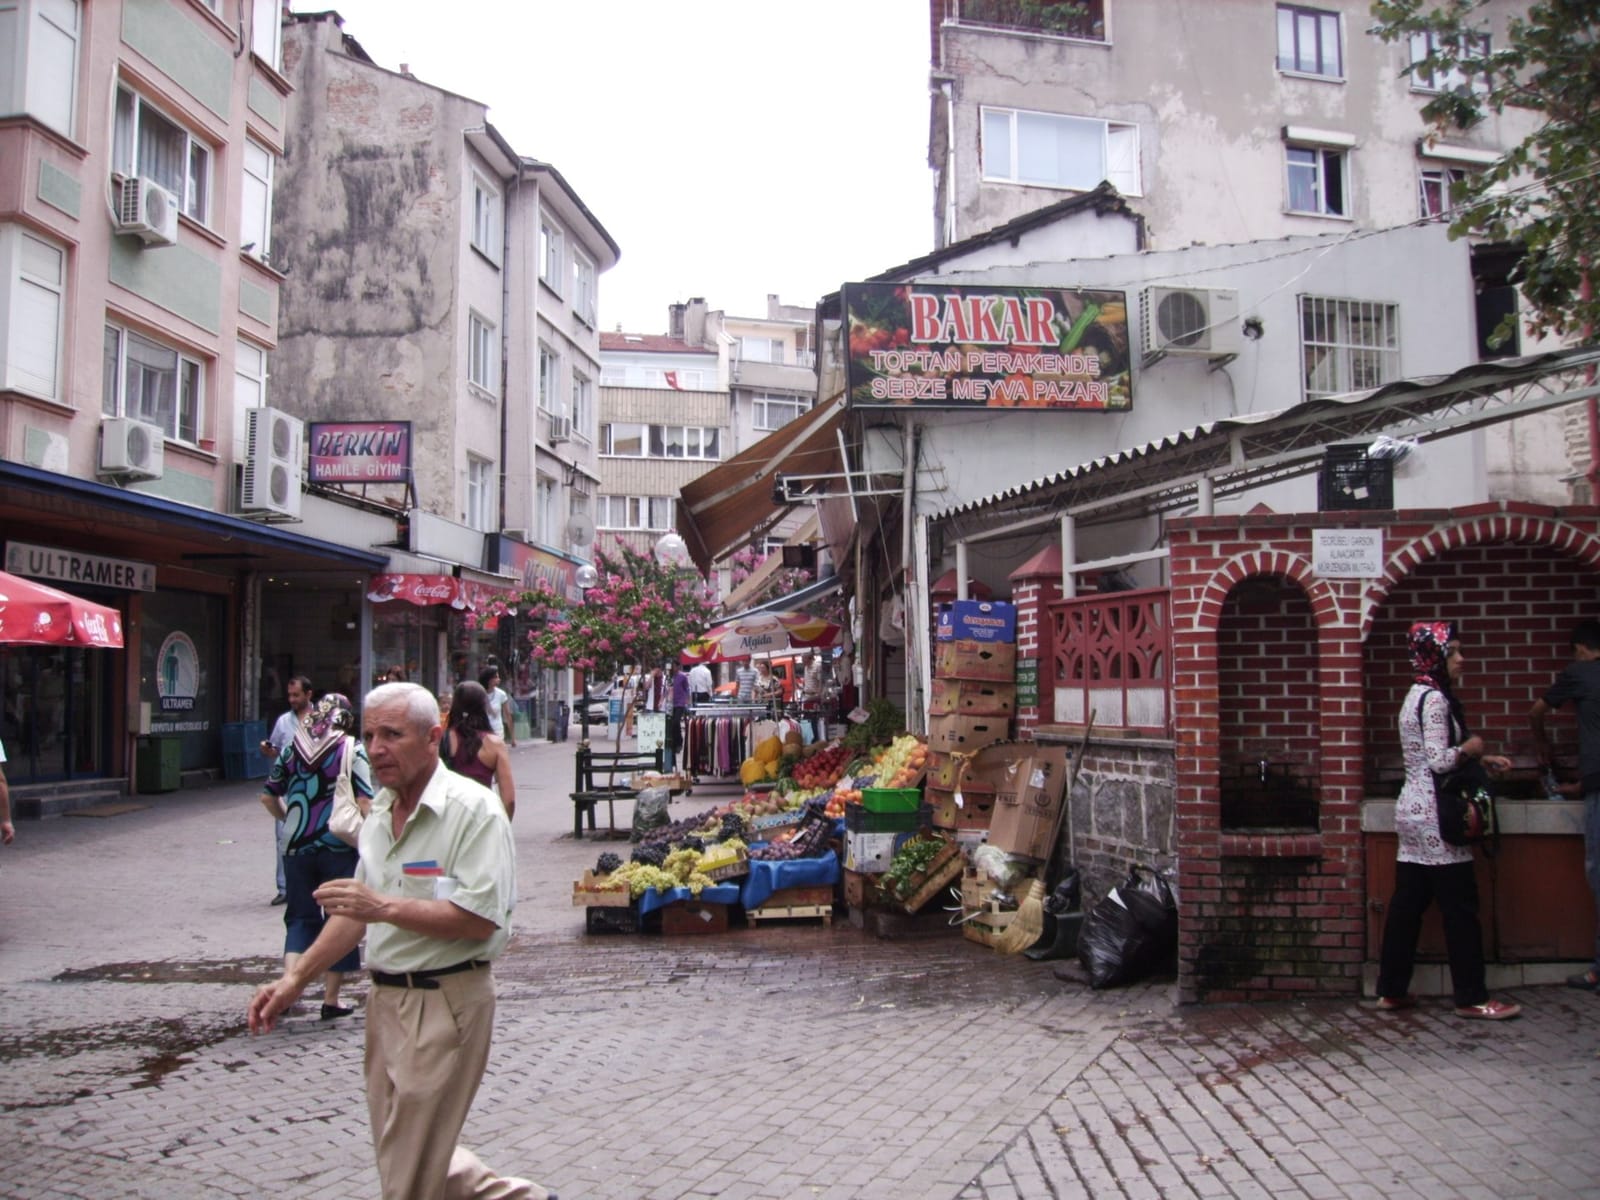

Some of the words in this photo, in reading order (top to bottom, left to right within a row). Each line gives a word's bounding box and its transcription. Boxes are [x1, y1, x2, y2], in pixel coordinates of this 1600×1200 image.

[909, 293, 1060, 346] BAKAR
[870, 350, 961, 372] TOPTAN
[967, 353, 1100, 375] PERAKENDE
[871, 378, 947, 400] SEBZE
[952, 379, 1027, 400] MEYVA
[1034, 381, 1108, 402] PAZARI
[316, 426, 402, 457] BERKİN
[367, 460, 401, 477] GİYİM
[28, 551, 136, 588] ULTRAMER
[740, 634, 773, 650] Algida
[162, 698, 194, 710] ULTRAMER
